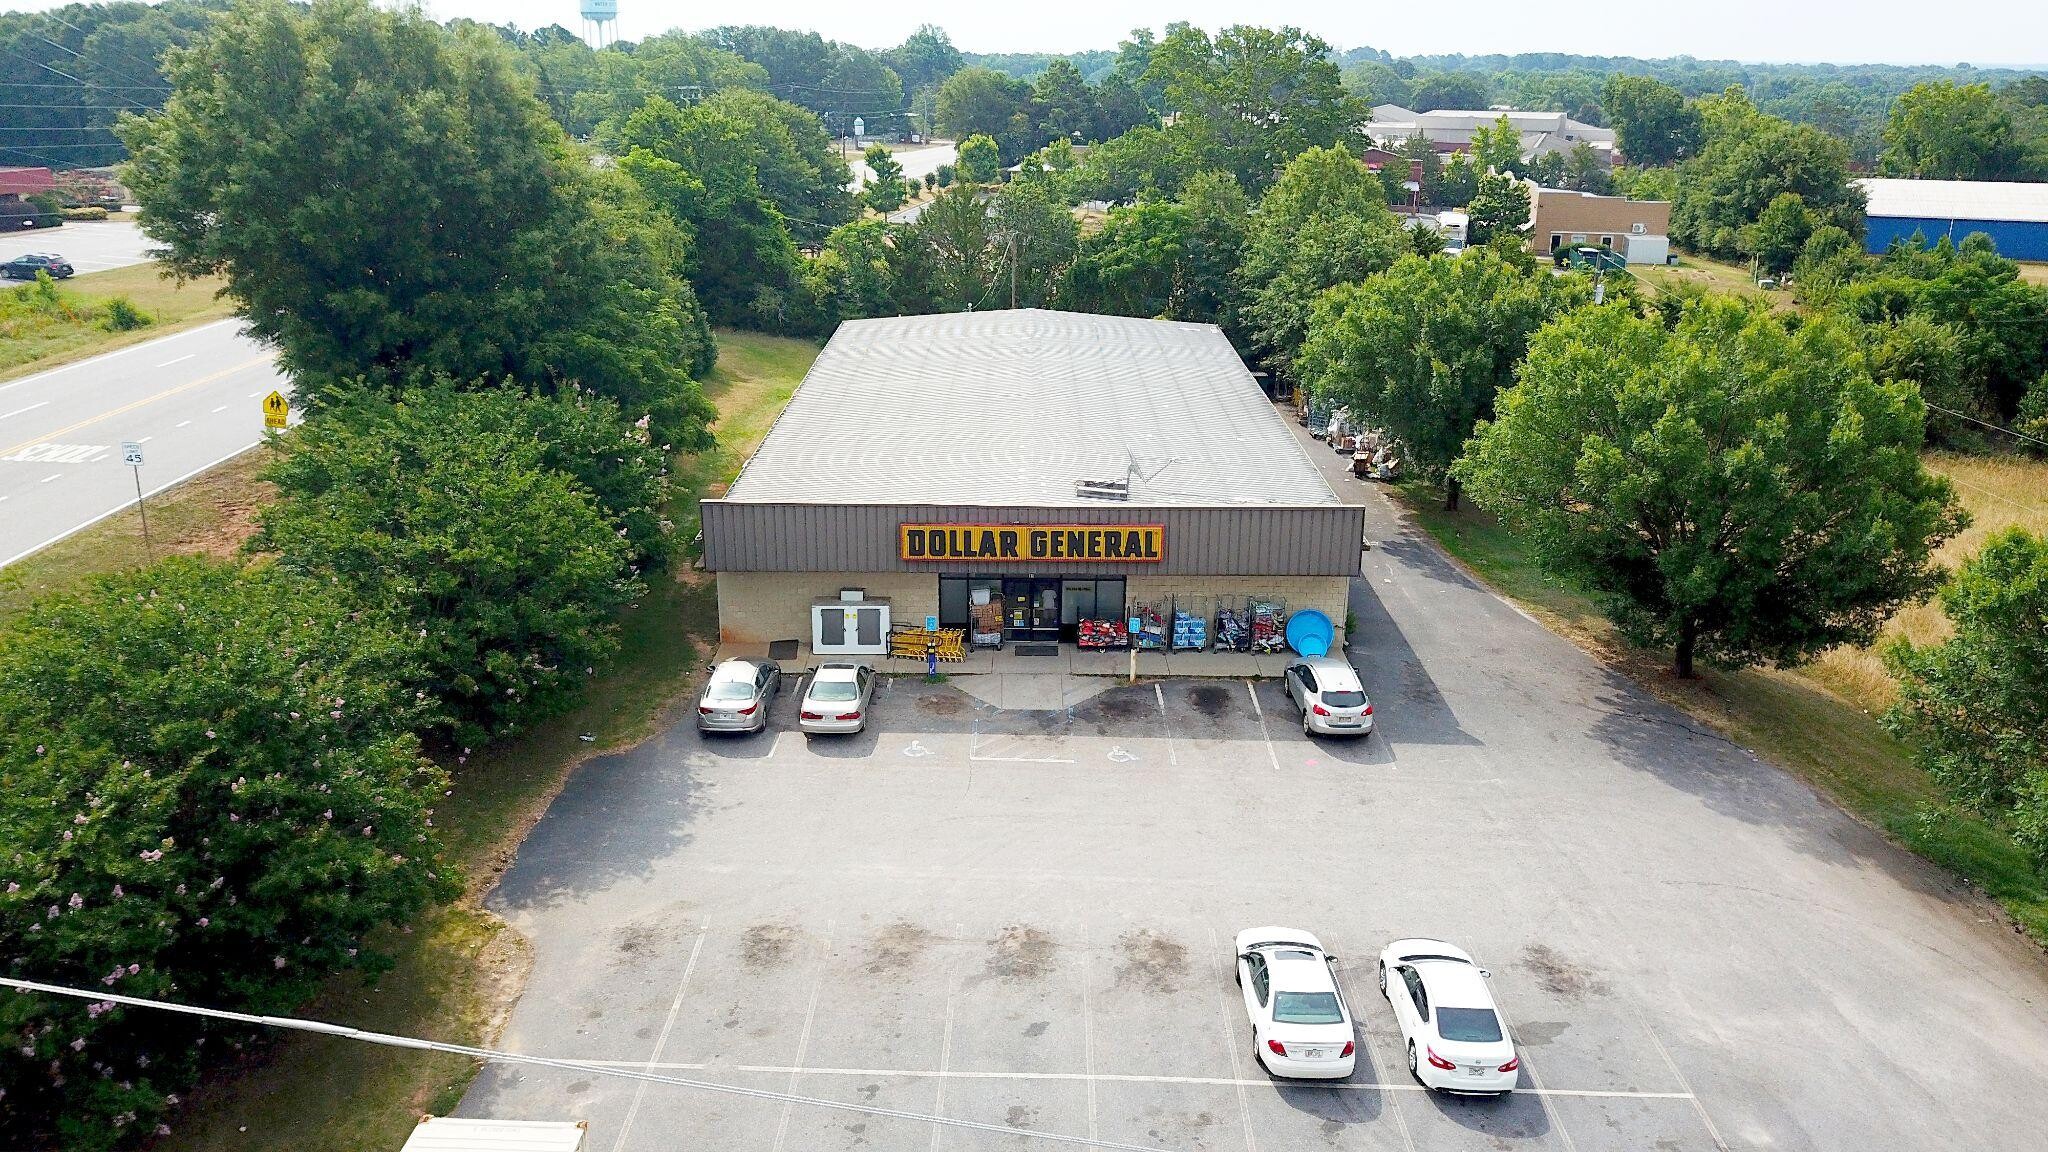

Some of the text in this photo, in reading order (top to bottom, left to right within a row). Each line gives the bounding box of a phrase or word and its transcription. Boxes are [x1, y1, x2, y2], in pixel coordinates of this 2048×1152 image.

[125, 454, 142, 463] 45
[907, 530, 1158, 557] DOLLAR GENERAL
